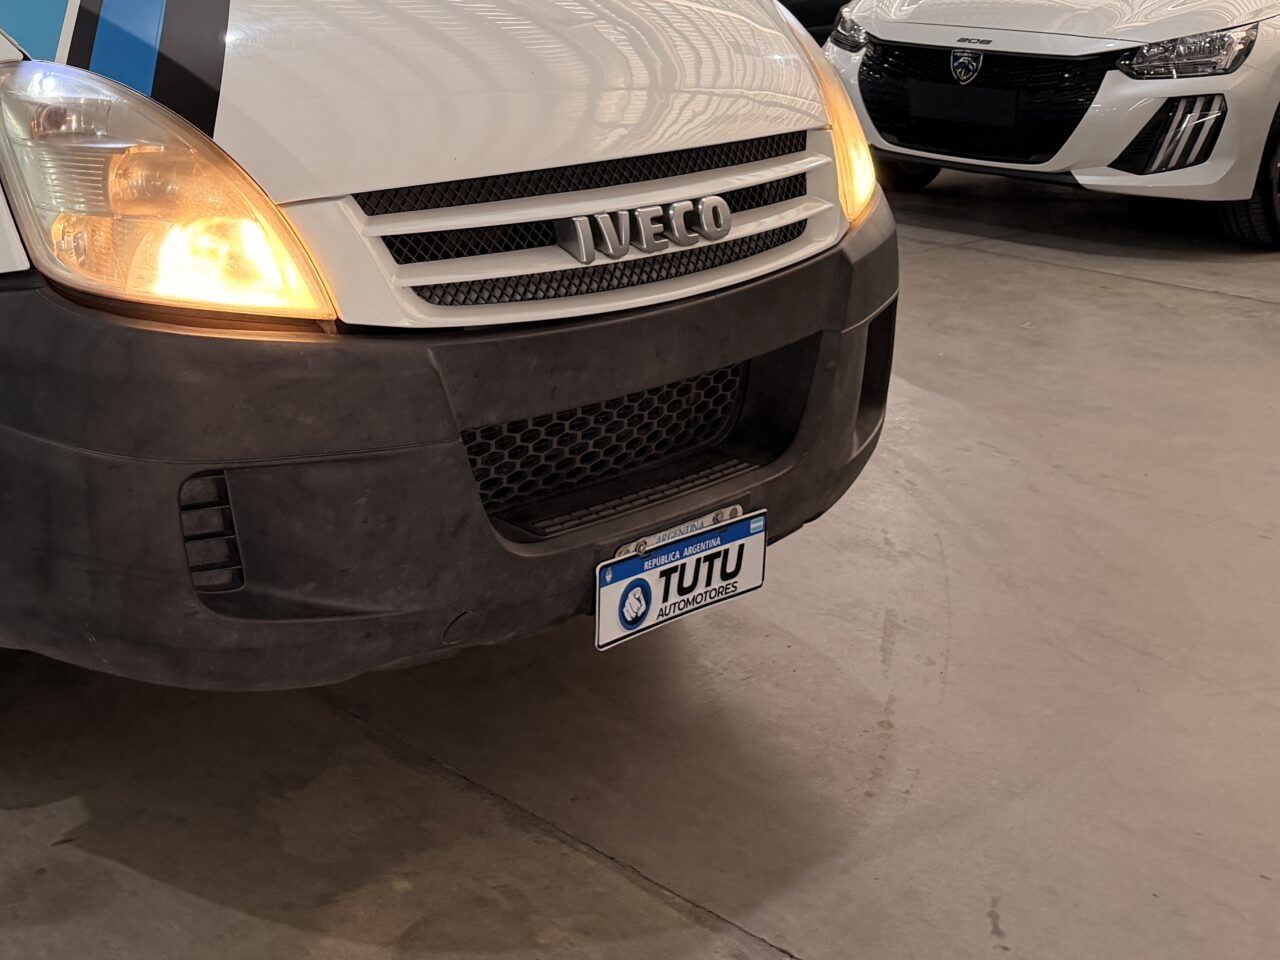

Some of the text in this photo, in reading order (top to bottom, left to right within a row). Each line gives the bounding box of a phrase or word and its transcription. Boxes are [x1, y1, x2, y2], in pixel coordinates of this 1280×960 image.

[570, 195, 732, 265] IVECO
[643, 536, 721, 571] REPÚBLICA ARGENTINA
[658, 542, 746, 605] TUTU
[655, 580, 739, 621] AUTOMOTORES
